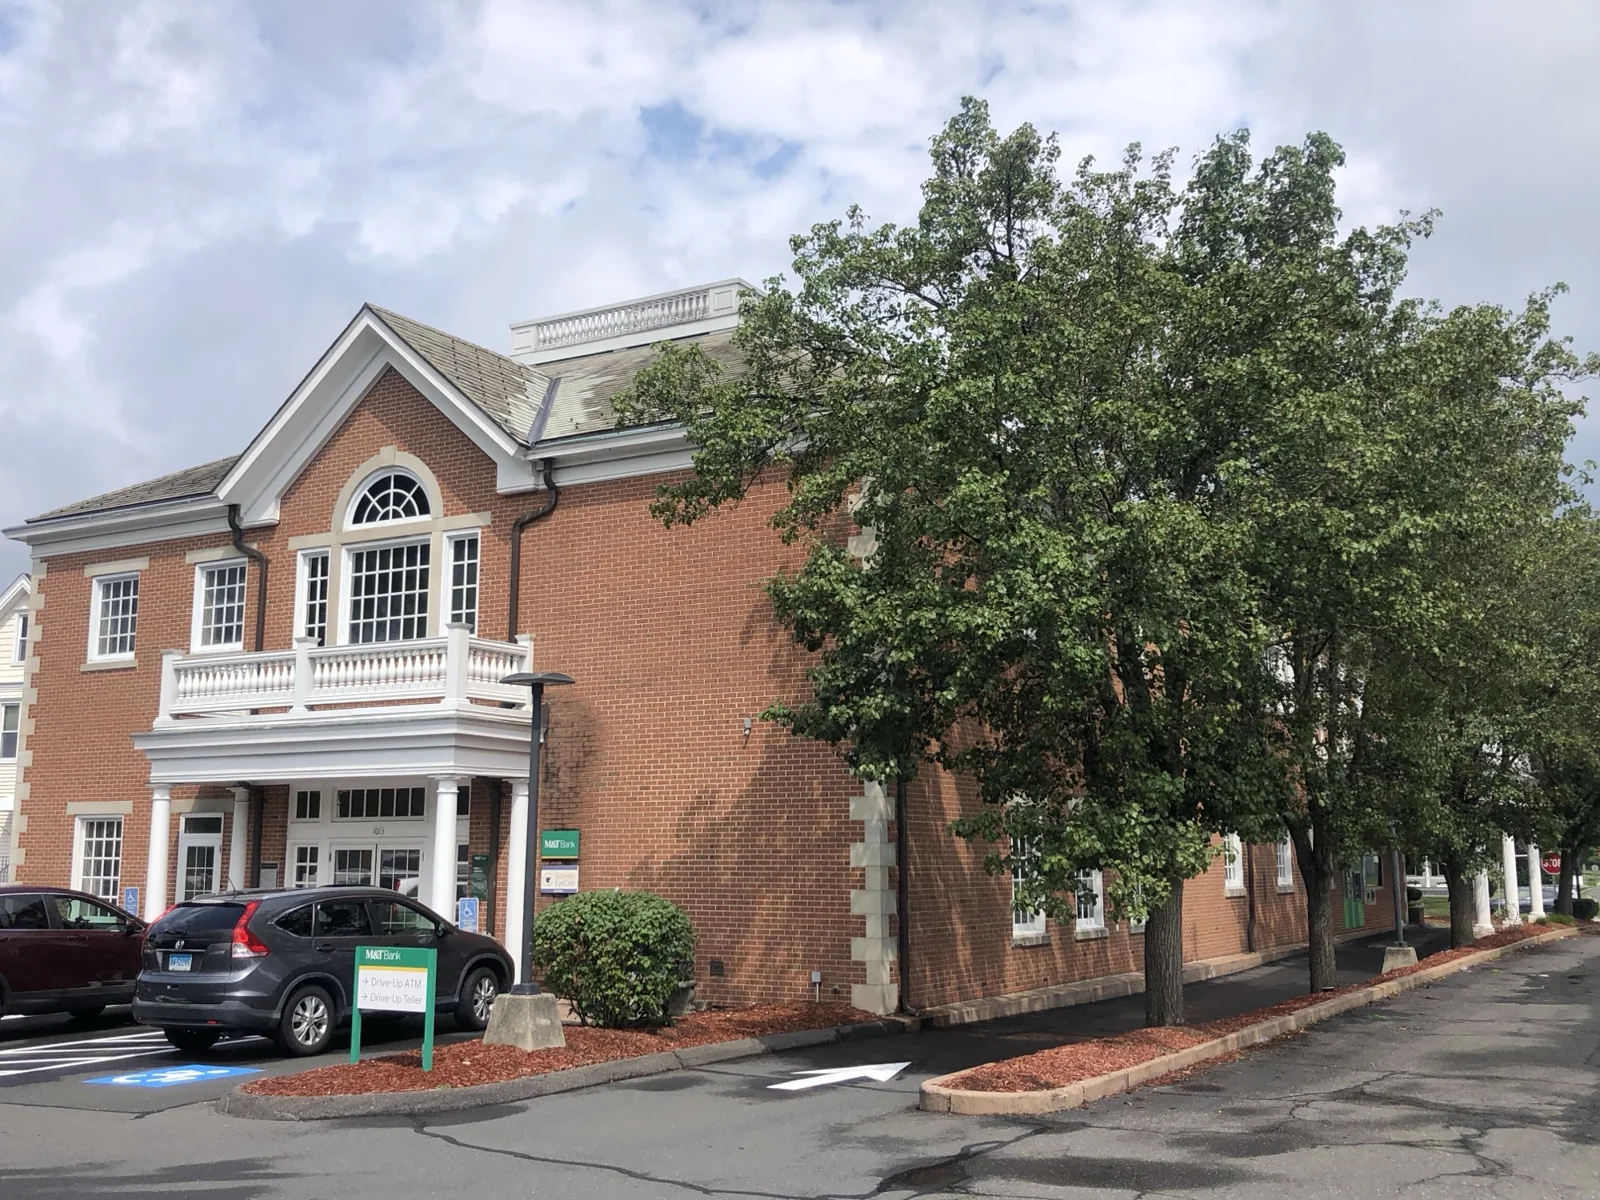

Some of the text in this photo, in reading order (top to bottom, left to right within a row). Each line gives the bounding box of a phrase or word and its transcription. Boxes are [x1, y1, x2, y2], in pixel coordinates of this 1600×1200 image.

[544, 839, 576, 849] M&T Bank
[365, 949, 402, 960] M&T Bank
[370, 977, 422, 989] Drive-Up ATM
[370, 992, 423, 1005] Drive-Up Teller
